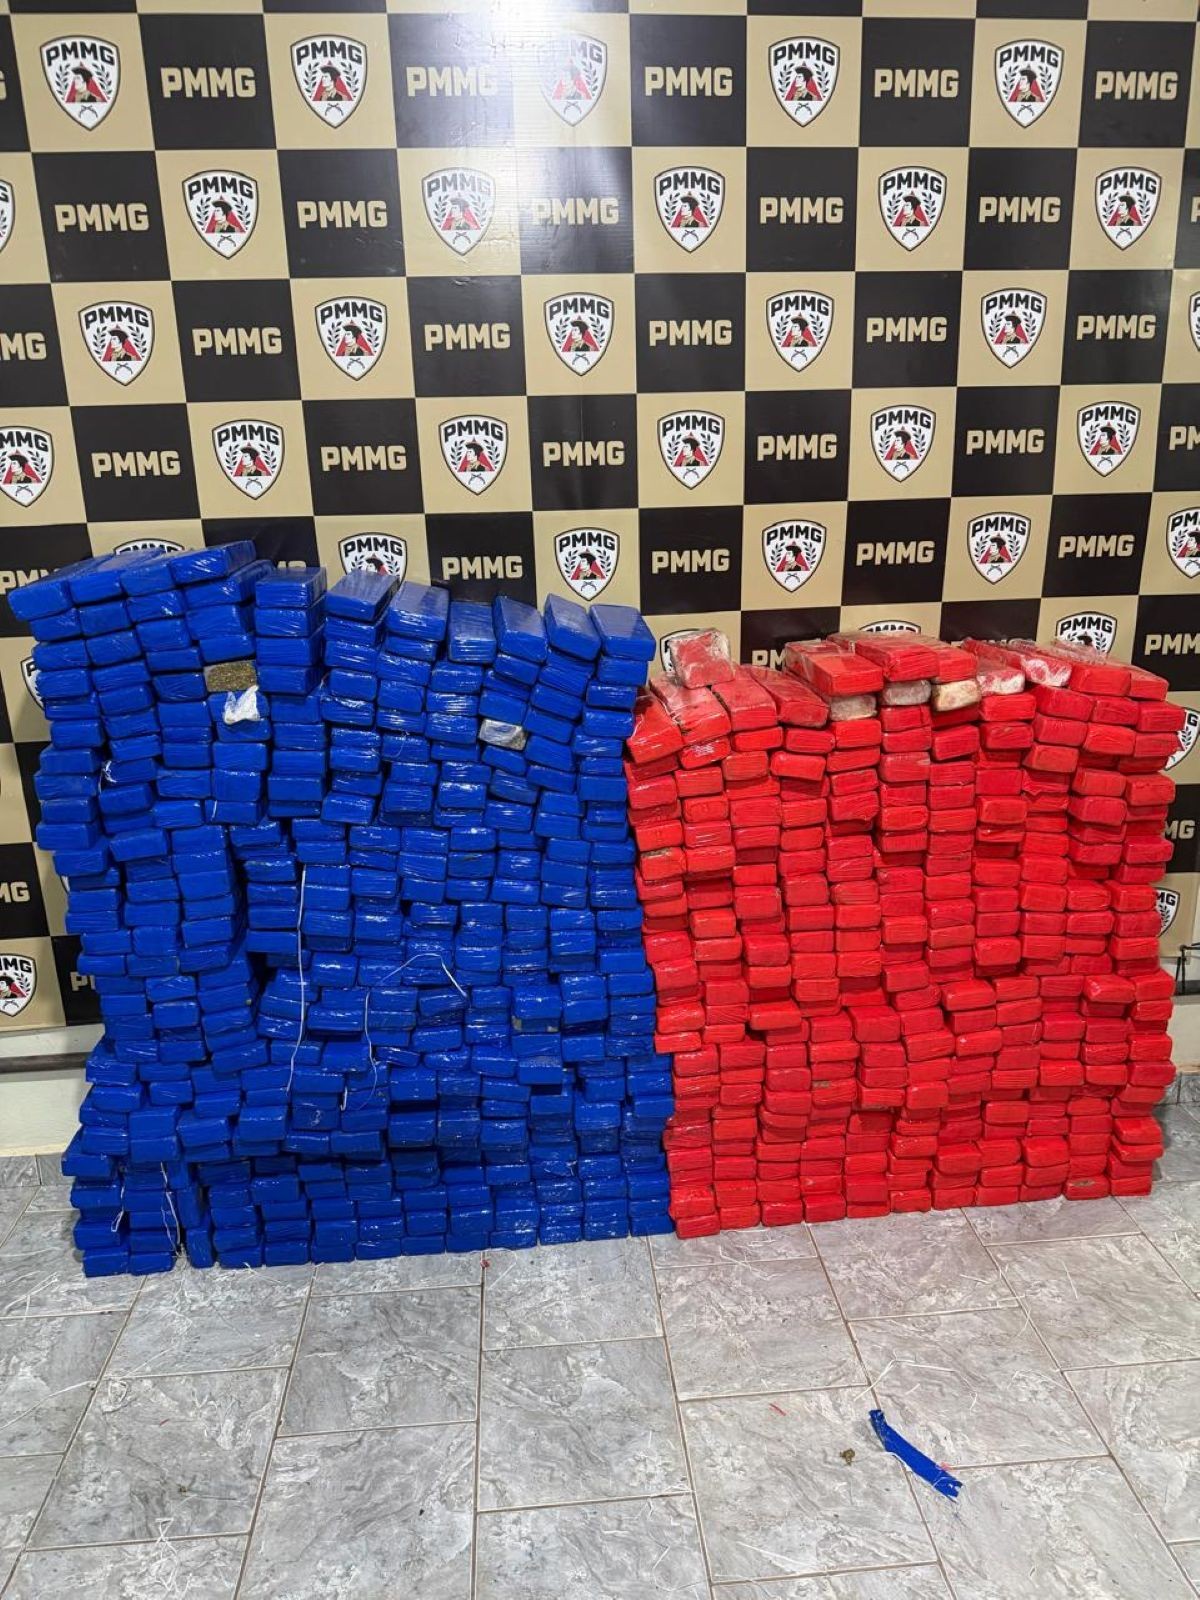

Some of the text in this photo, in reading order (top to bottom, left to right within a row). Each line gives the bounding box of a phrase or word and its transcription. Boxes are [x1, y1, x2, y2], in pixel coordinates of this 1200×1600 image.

[46, 41, 115, 66] PMMG
[296, 40, 363, 65] PMMG
[773, 41, 835, 66] PMMG
[999, 45, 1059, 68] PMMG
[160, 66, 257, 98] PMMG
[644, 66, 733, 97] PMMG
[874, 68, 960, 98] PMMG
[1095, 71, 1178, 100] PMMG
[187, 177, 254, 200] PMMG
[426, 172, 491, 198] PMMG
[659, 173, 721, 196] PMMG
[882, 171, 942, 194] PMMG
[1099, 173, 1157, 195] PMMG
[54, 203, 149, 233] PMMG
[296, 200, 388, 229] PMMG
[532, 197, 619, 226] PMMG
[759, 197, 844, 225] PMMG
[978, 196, 1061, 223] PMMG
[320, 301, 383, 324] PMMG
[549, 298, 609, 320] PMMG
[771, 294, 830, 317] PMMG
[985, 293, 1042, 315] PMMG
[84, 305, 149, 329] PMMG
[1076, 315, 1157, 340] PMMG
[192, 327, 283, 356] PMMG
[424, 323, 511, 351] PMMG
[649, 320, 732, 346] PMMG
[866, 317, 948, 343] PMMG
[0, 332, 47, 361] MG
[662, 416, 721, 438] PMMG
[875, 411, 932, 431] PMMG
[1081, 406, 1137, 426] PMMG
[0, 430, 48, 452] MMG
[216, 424, 280, 446] PMMG
[444, 420, 504, 442] PMMG
[966, 429, 1045, 455] PMMG
[1169, 425, 1200, 451] PM
[321, 445, 407, 472] PMMG
[542, 440, 625, 467] PMMG
[757, 434, 838, 461] PMMG
[91, 450, 182, 477] PMMG
[766, 525, 822, 547] PMMG
[971, 517, 1027, 538] PMMG
[344, 536, 403, 557] PMMG
[559, 532, 616, 553] PMMG
[856, 541, 935, 566] PMMG
[1058, 535, 1135, 559] PMMG
[442, 555, 523, 580] PMMG
[651, 549, 730, 574] PMMG
[1060, 619, 1113, 640] PMMG
[1144, 633, 1200, 655] PMM
[1164, 819, 1196, 841] MG
